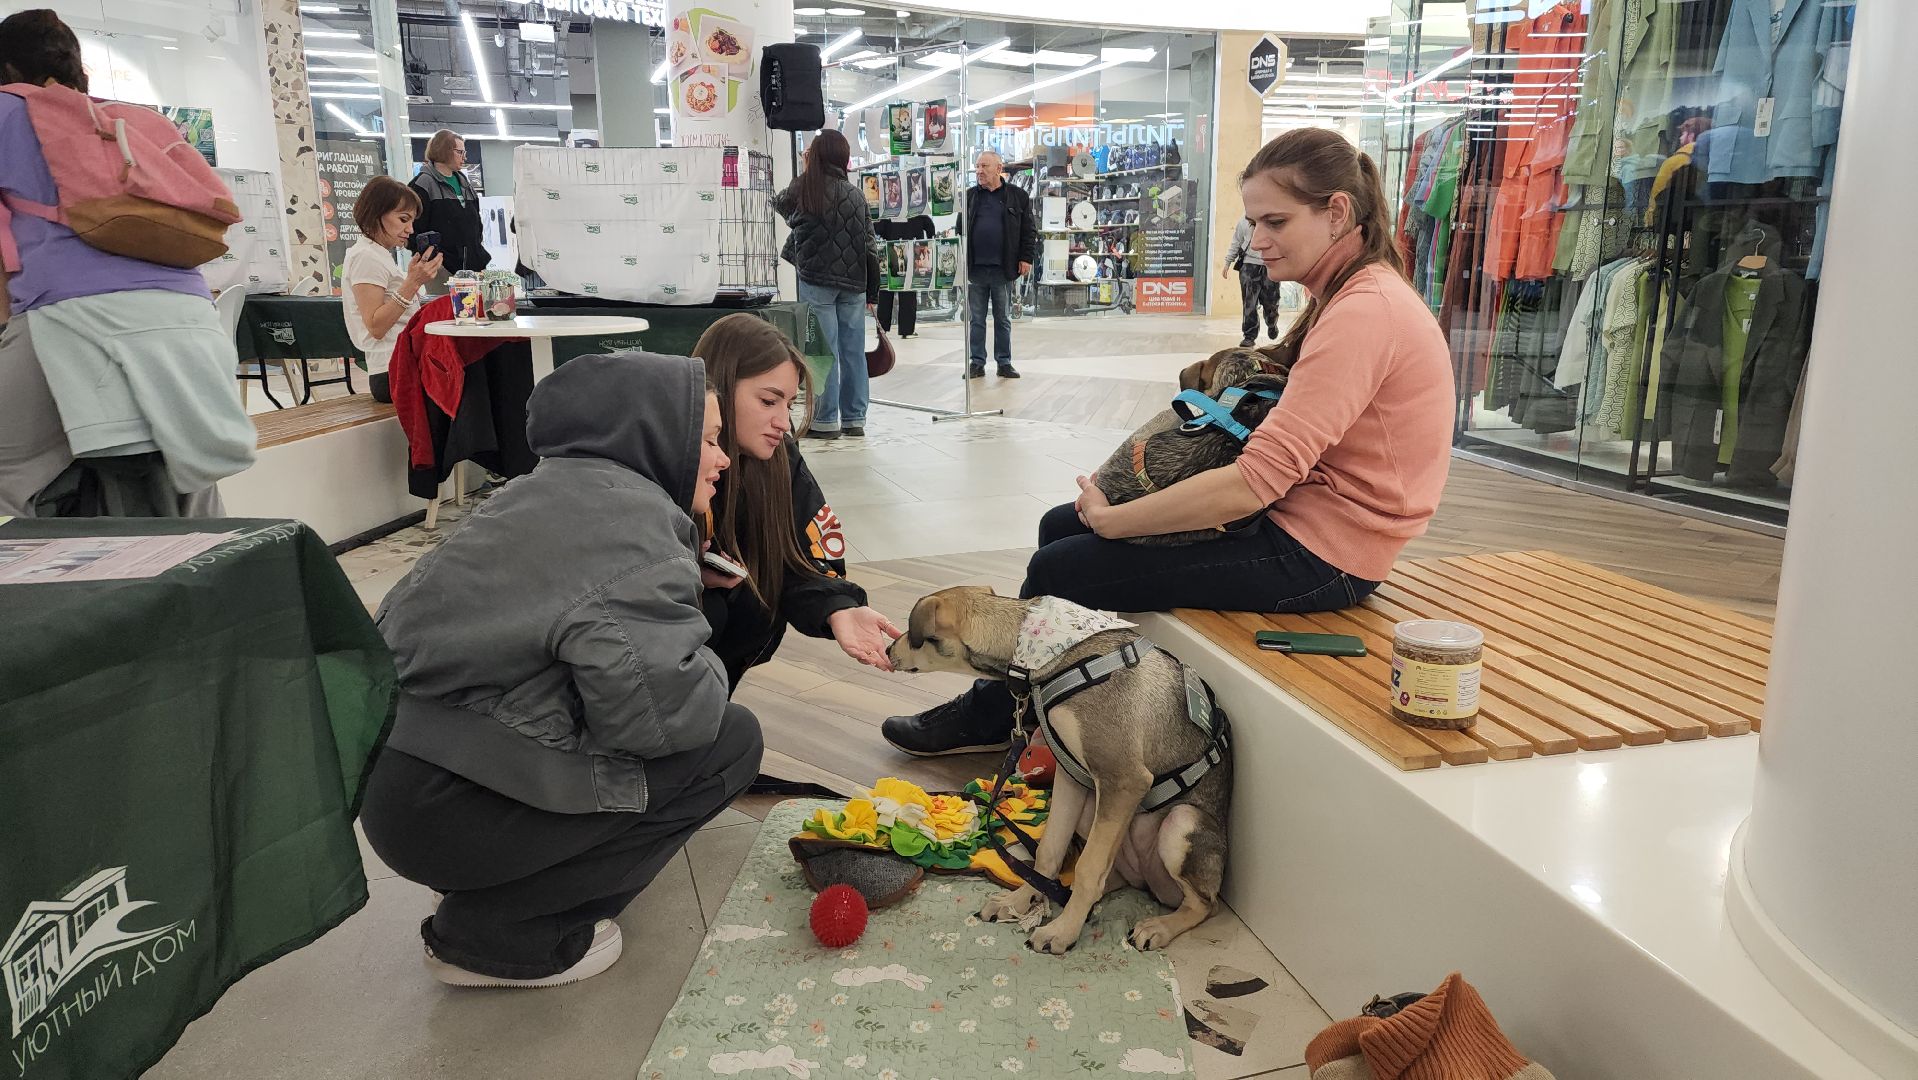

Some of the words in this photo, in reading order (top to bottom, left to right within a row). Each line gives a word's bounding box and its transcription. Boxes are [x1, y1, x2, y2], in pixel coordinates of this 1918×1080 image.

[1251, 54, 1276, 69] DNS
[316, 152, 374, 164] РИГЛАШАЕМ
[318, 164, 325, 172] А
[327, 164, 359, 174] РАБОТУ
[334, 181, 368, 189] ДОСТОЙН
[1142, 282, 1188, 295] DNS
[12, 960, 123, 1077] УЮТНЫЙ
[132, 919, 196, 985] ДОМ
